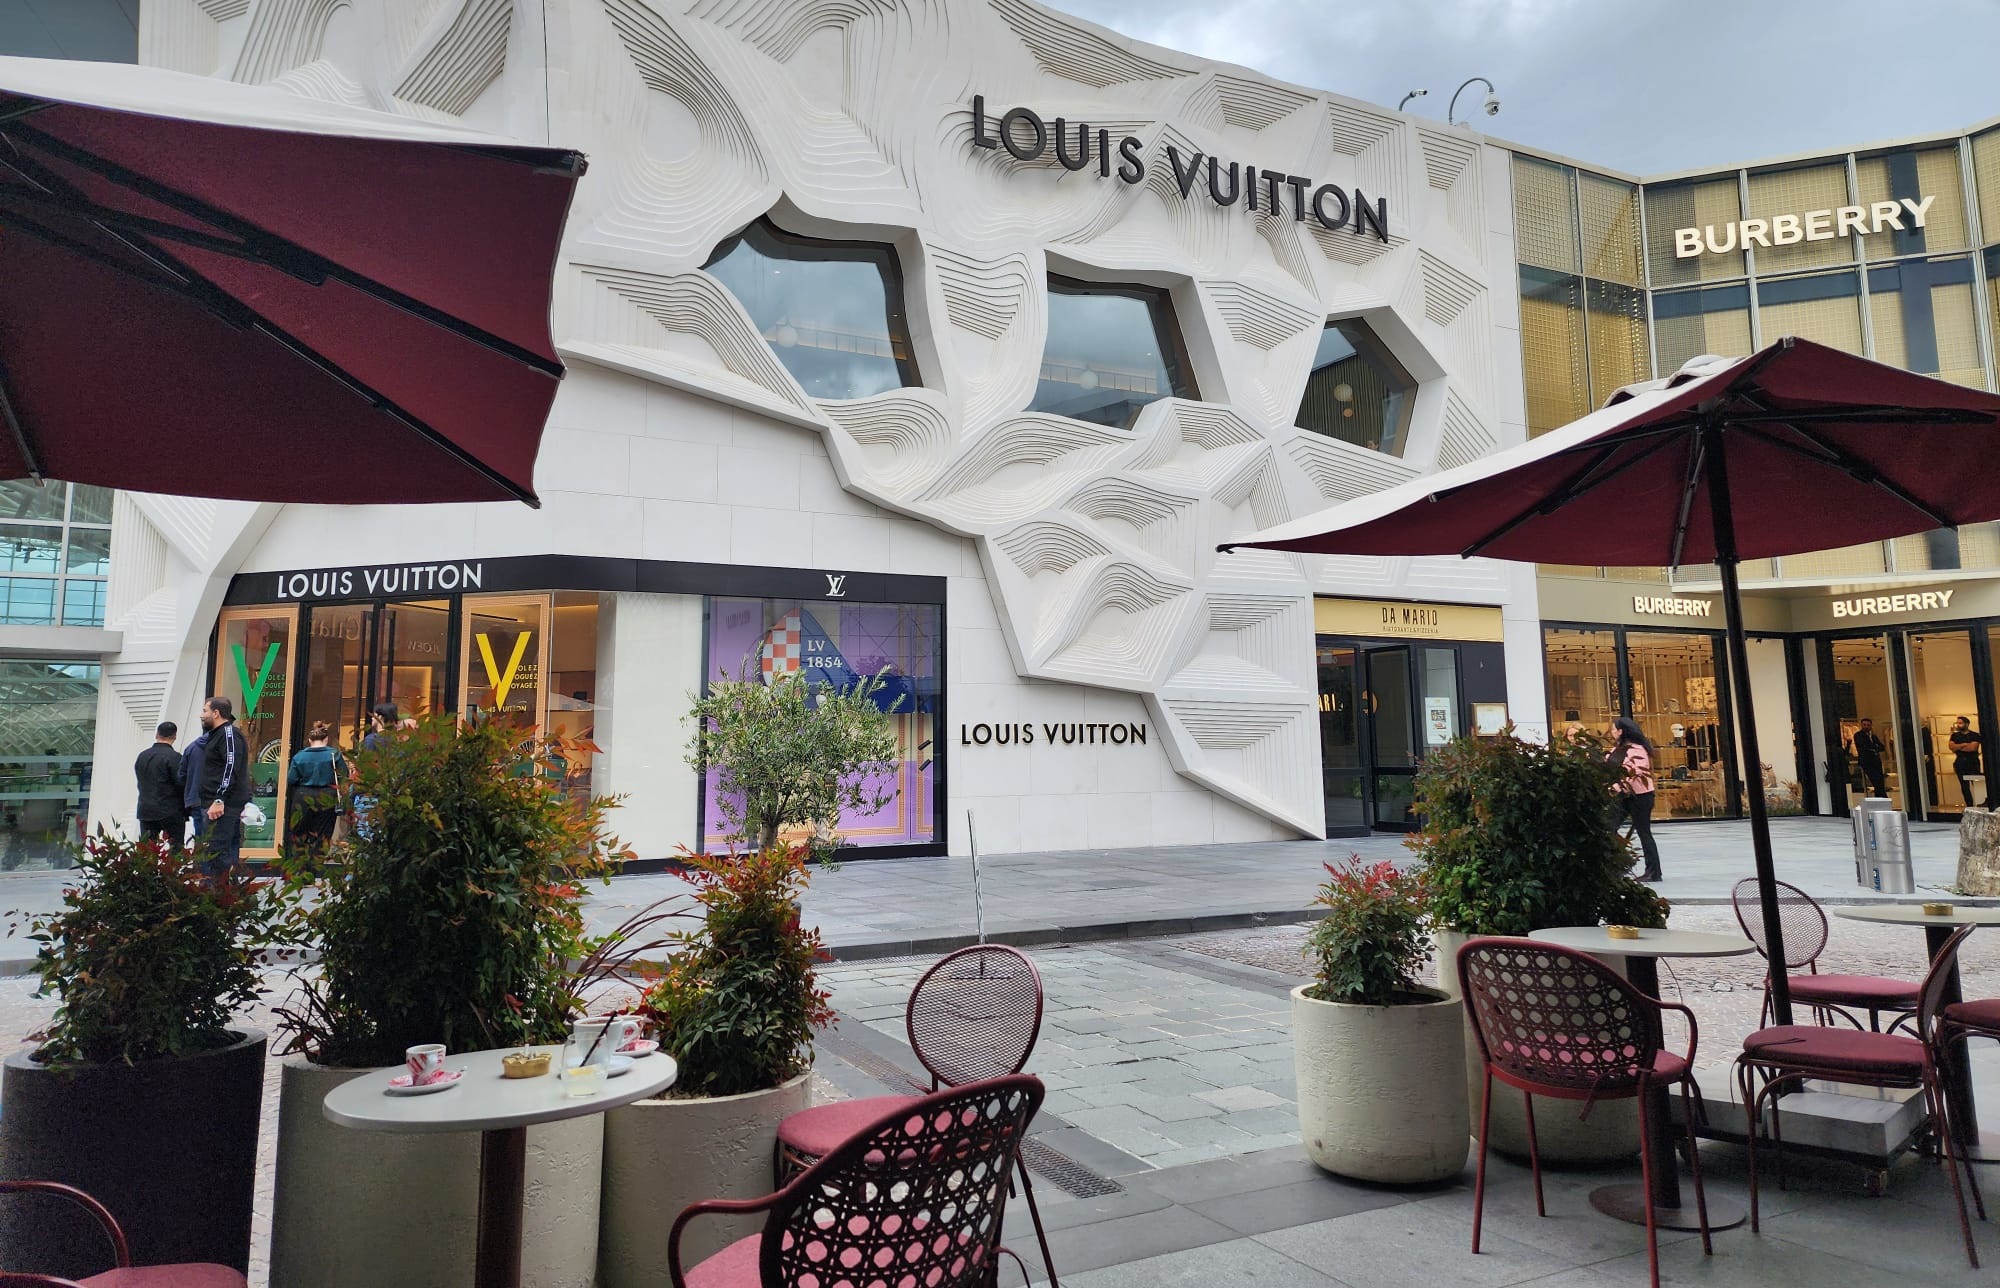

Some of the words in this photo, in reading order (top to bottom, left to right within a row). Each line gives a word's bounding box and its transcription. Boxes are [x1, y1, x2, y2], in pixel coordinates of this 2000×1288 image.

[973, 94, 1145, 185] LOUIS
[1166, 145, 1389, 244] VUITTON
[1674, 195, 1936, 259] BURBERRY
[277, 571, 353, 598] LOUIS
[364, 563, 482, 595] VUITTON
[1634, 596, 1711, 617] BURBERRY
[1832, 590, 1954, 618] BURBERRY
[1382, 607, 1396, 623] DA
[1402, 608, 1438, 626] MARIO
[807, 640, 825, 652] LV
[807, 656, 843, 668] 1854
[961, 723, 1034, 745] LOUIS
[1043, 723, 1147, 745] VUITTON
